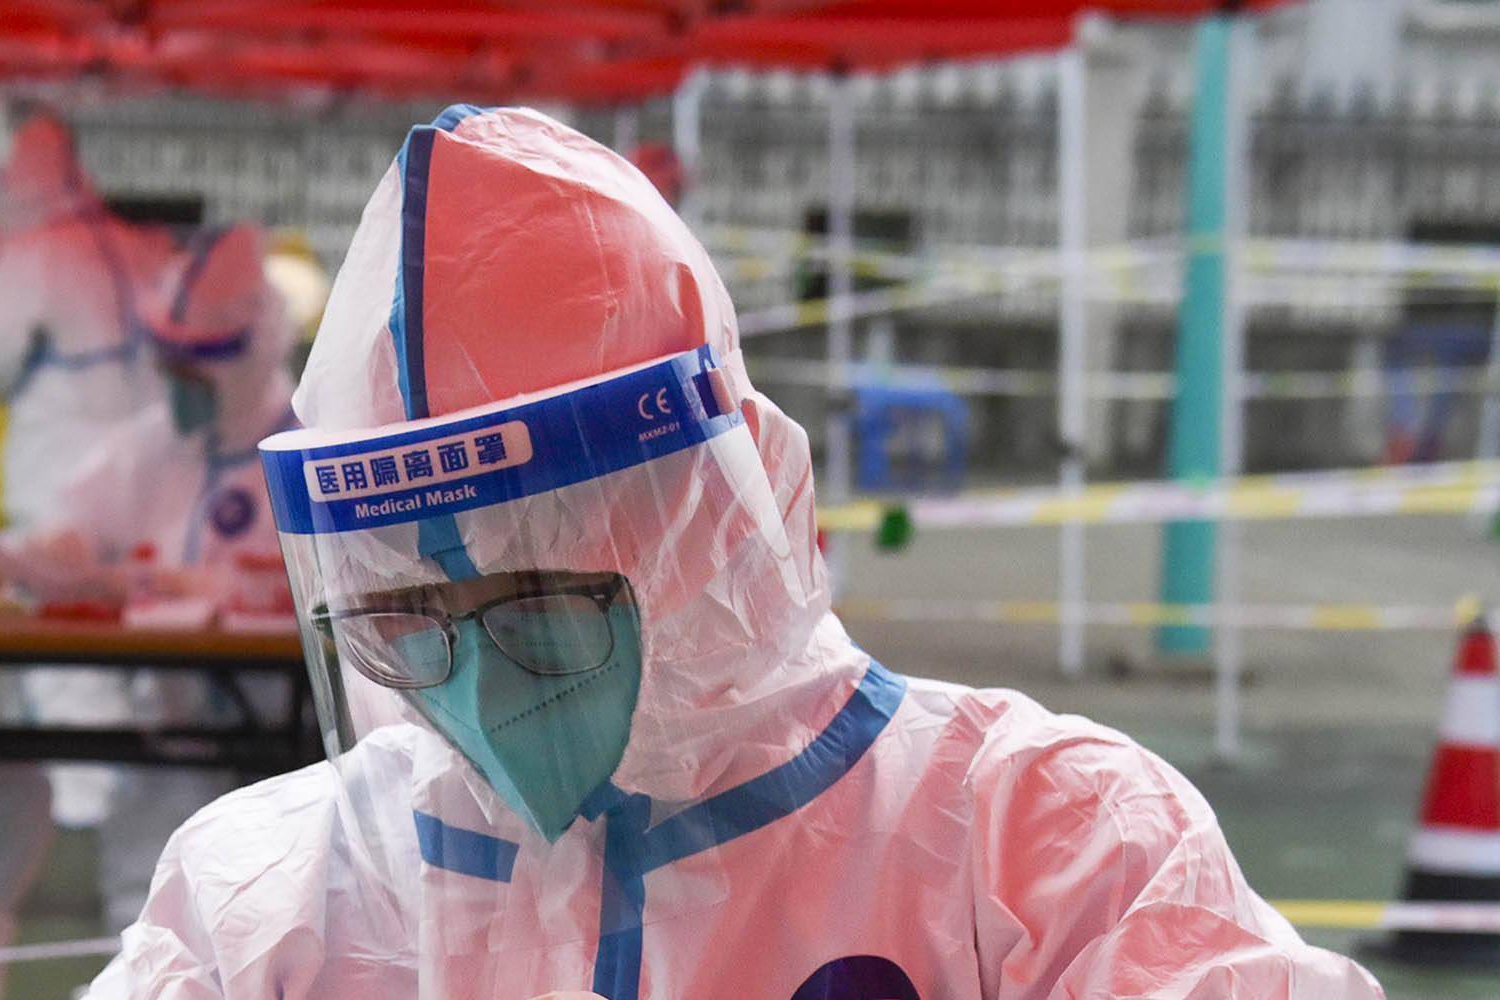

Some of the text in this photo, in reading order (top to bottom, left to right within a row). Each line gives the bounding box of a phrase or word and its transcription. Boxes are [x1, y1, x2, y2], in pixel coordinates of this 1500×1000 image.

[638, 387, 672, 420] CE
[315, 432, 508, 494] 医用隔离面罩
[355, 484, 478, 519] Medical Mask
